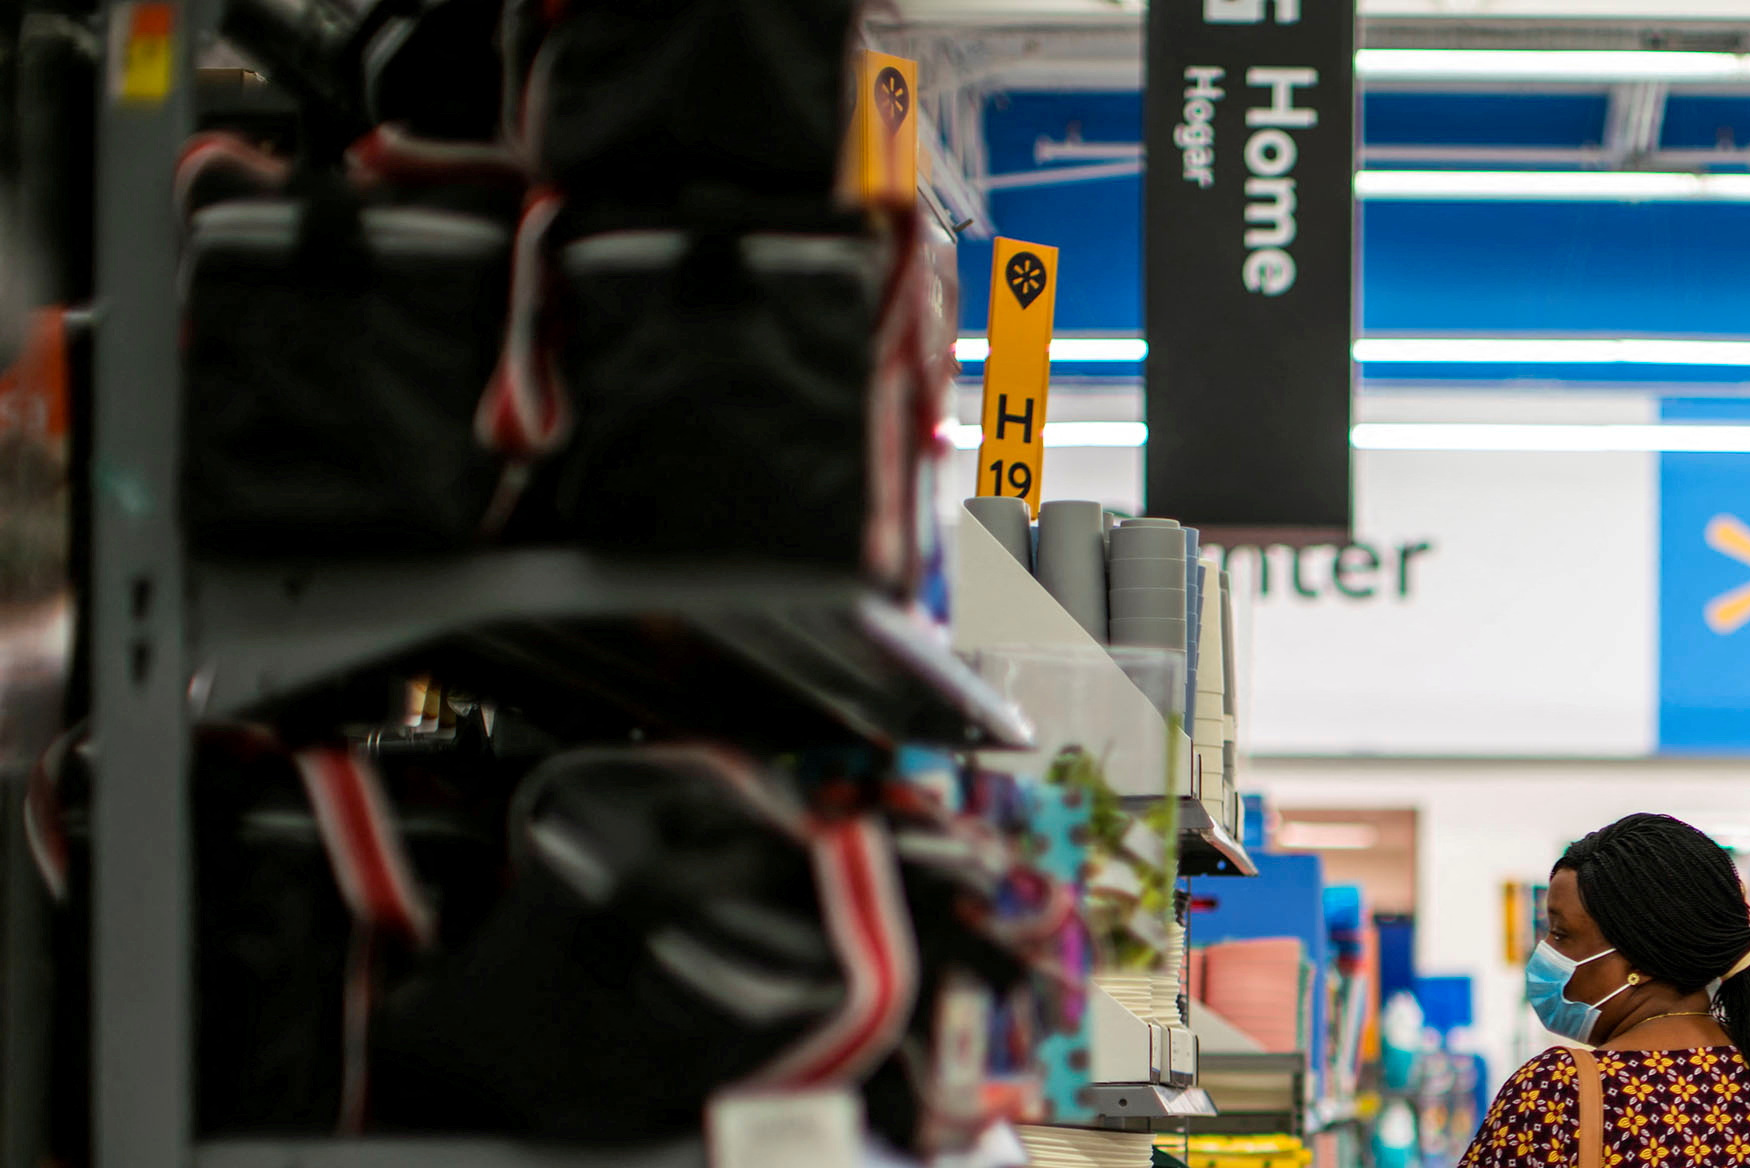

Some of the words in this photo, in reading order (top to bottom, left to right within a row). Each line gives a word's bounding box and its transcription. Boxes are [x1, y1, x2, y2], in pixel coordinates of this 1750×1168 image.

[1173, 65, 1227, 189] Hogar
[1242, 65, 1320, 297] Home
[996, 394, 1034, 443] H
[990, 460, 1032, 498] 19
